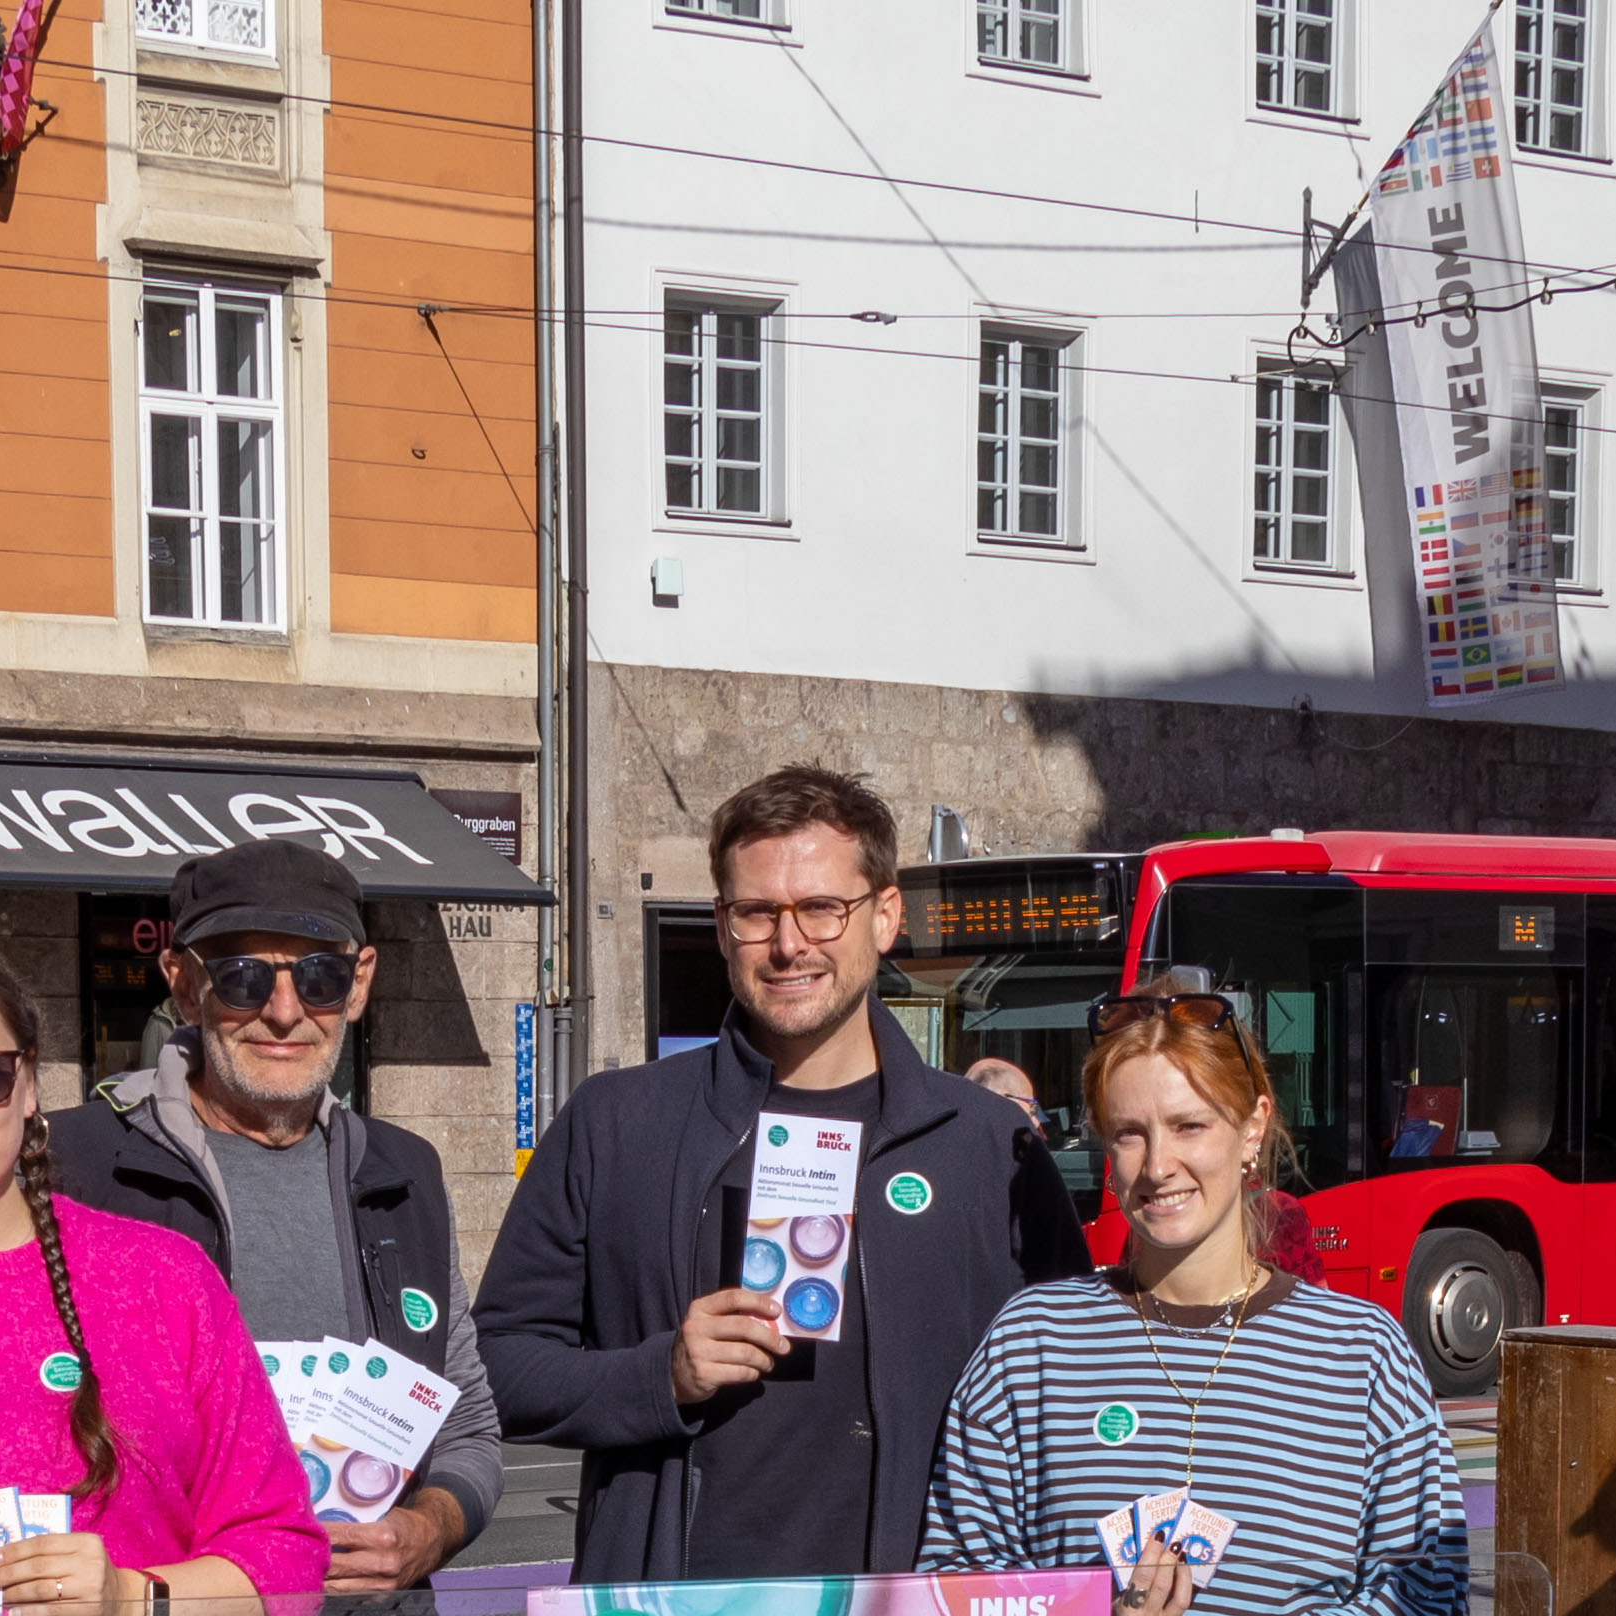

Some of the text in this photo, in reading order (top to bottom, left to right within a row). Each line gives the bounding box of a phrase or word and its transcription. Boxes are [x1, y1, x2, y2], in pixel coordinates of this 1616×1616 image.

[1427, 202, 1491, 464] WELCOME
[453, 814, 515, 833] rggraben
[1515, 916, 1534, 941] M
[817, 1140, 851, 1151] BRUCK
[759, 1164, 836, 1181] Innsbruck Intim
[343, 1387, 390, 1417] Innsbruck
[388, 1413, 414, 1433] Intim
[408, 1391, 442, 1413] BRUCK
[1191, 1508, 1229, 1532] ACHTUNG
[1191, 1520, 1219, 1538] FERTIG
[1183, 1538, 1212, 1561] LOS
